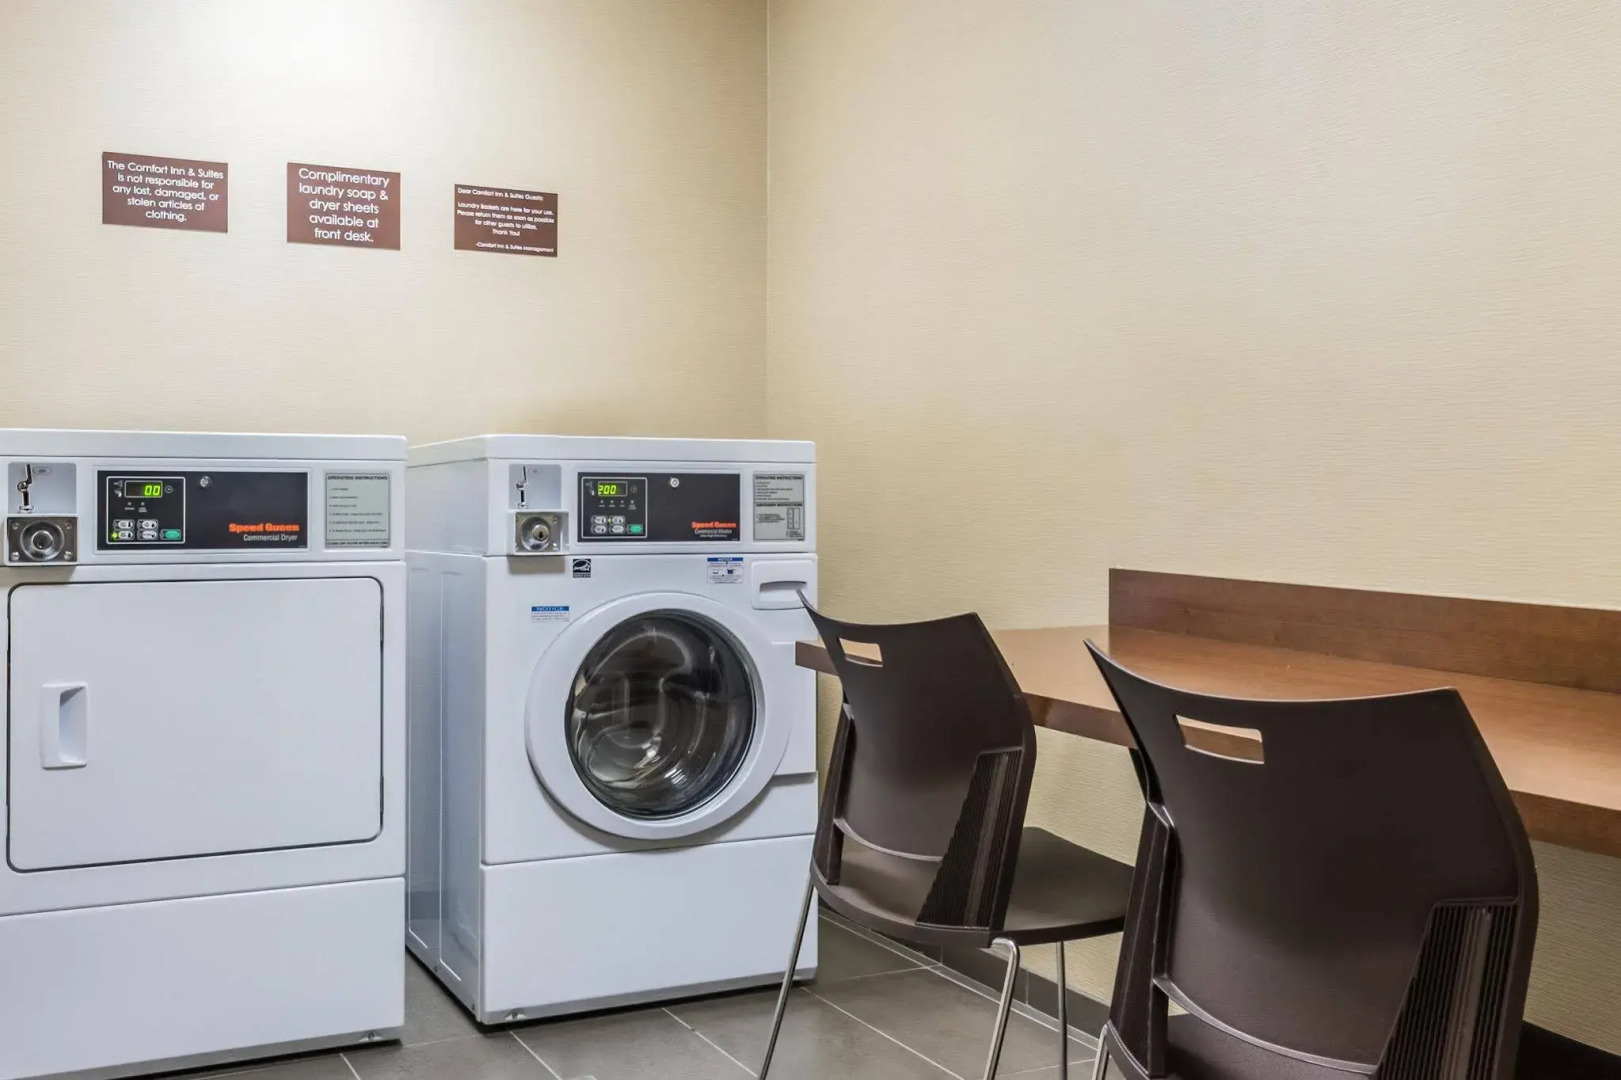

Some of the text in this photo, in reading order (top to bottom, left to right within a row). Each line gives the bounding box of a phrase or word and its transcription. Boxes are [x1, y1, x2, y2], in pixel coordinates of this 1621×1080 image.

[108, 160, 223, 179] The Comfort Inn & Suites
[118, 173, 124, 181] is
[146, 176, 198, 188] responsible
[201, 180, 214, 189] for
[299, 168, 390, 188] Complimentary
[112, 185, 131, 194] any
[134, 186, 151, 196] lost,
[299, 183, 388, 201] laundry soap &
[128, 198, 205, 211] stolen articles of
[309, 199, 379, 214] dryer sheets
[146, 210, 187, 222] clothing.
[309, 215, 379, 228] available at
[314, 228, 373, 242] front desk.
[144, 485, 160, 495] 00
[229, 523, 299, 533] Speed Queen
